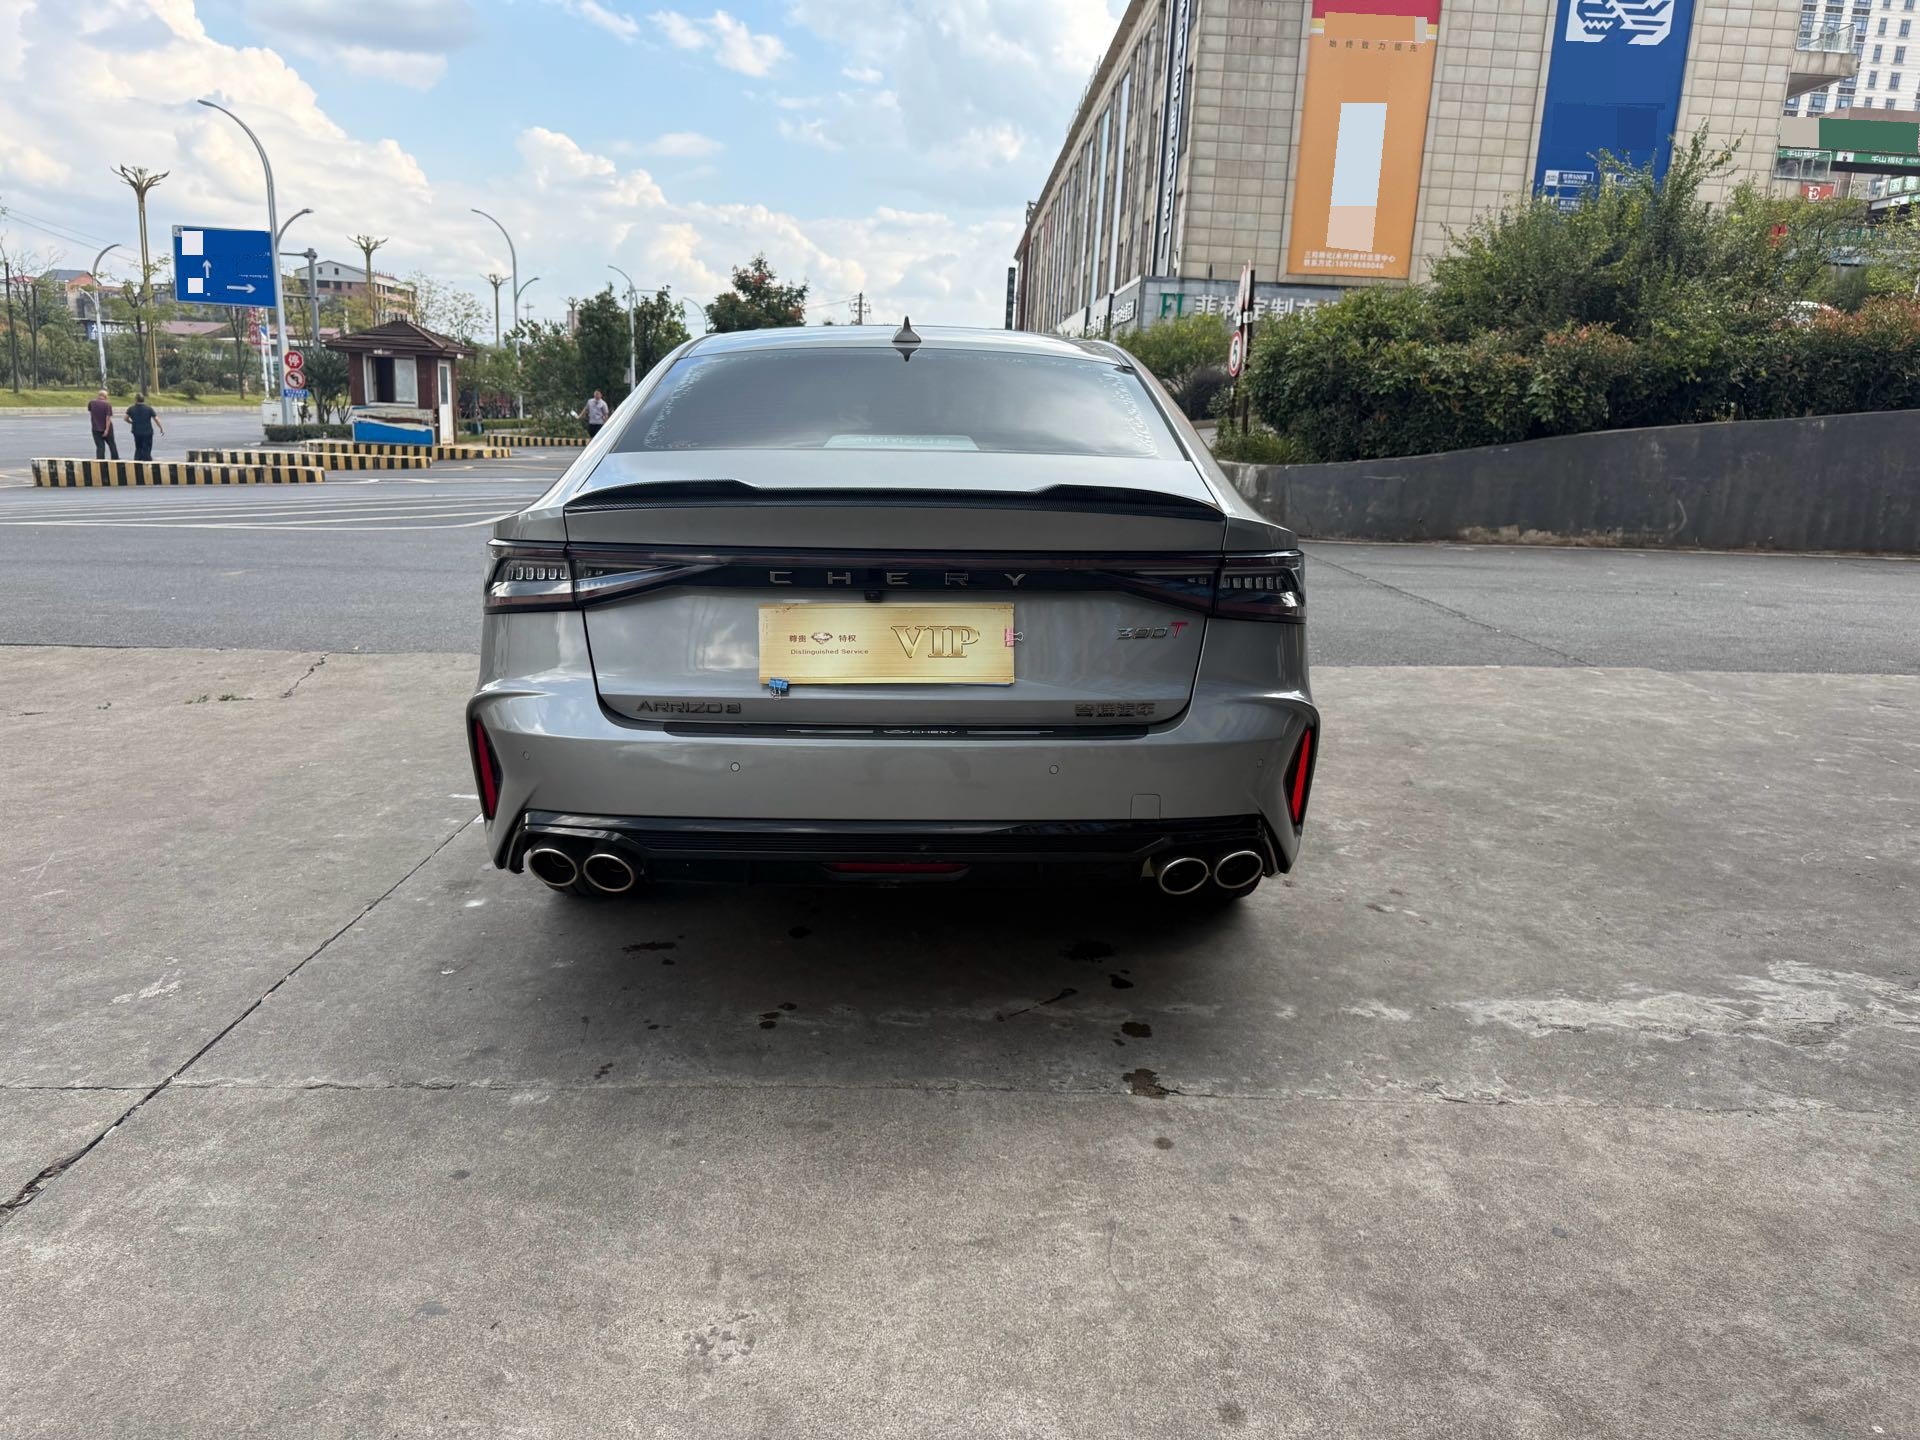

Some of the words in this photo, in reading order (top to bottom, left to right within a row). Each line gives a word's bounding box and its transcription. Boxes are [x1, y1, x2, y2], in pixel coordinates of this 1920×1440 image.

[288, 354, 301, 367] 停
[769, 570, 1027, 587] CHERY
[838, 634, 857, 643] 特权
[890, 625, 981, 658] VIP
[790, 648, 839, 656] Distinguished
